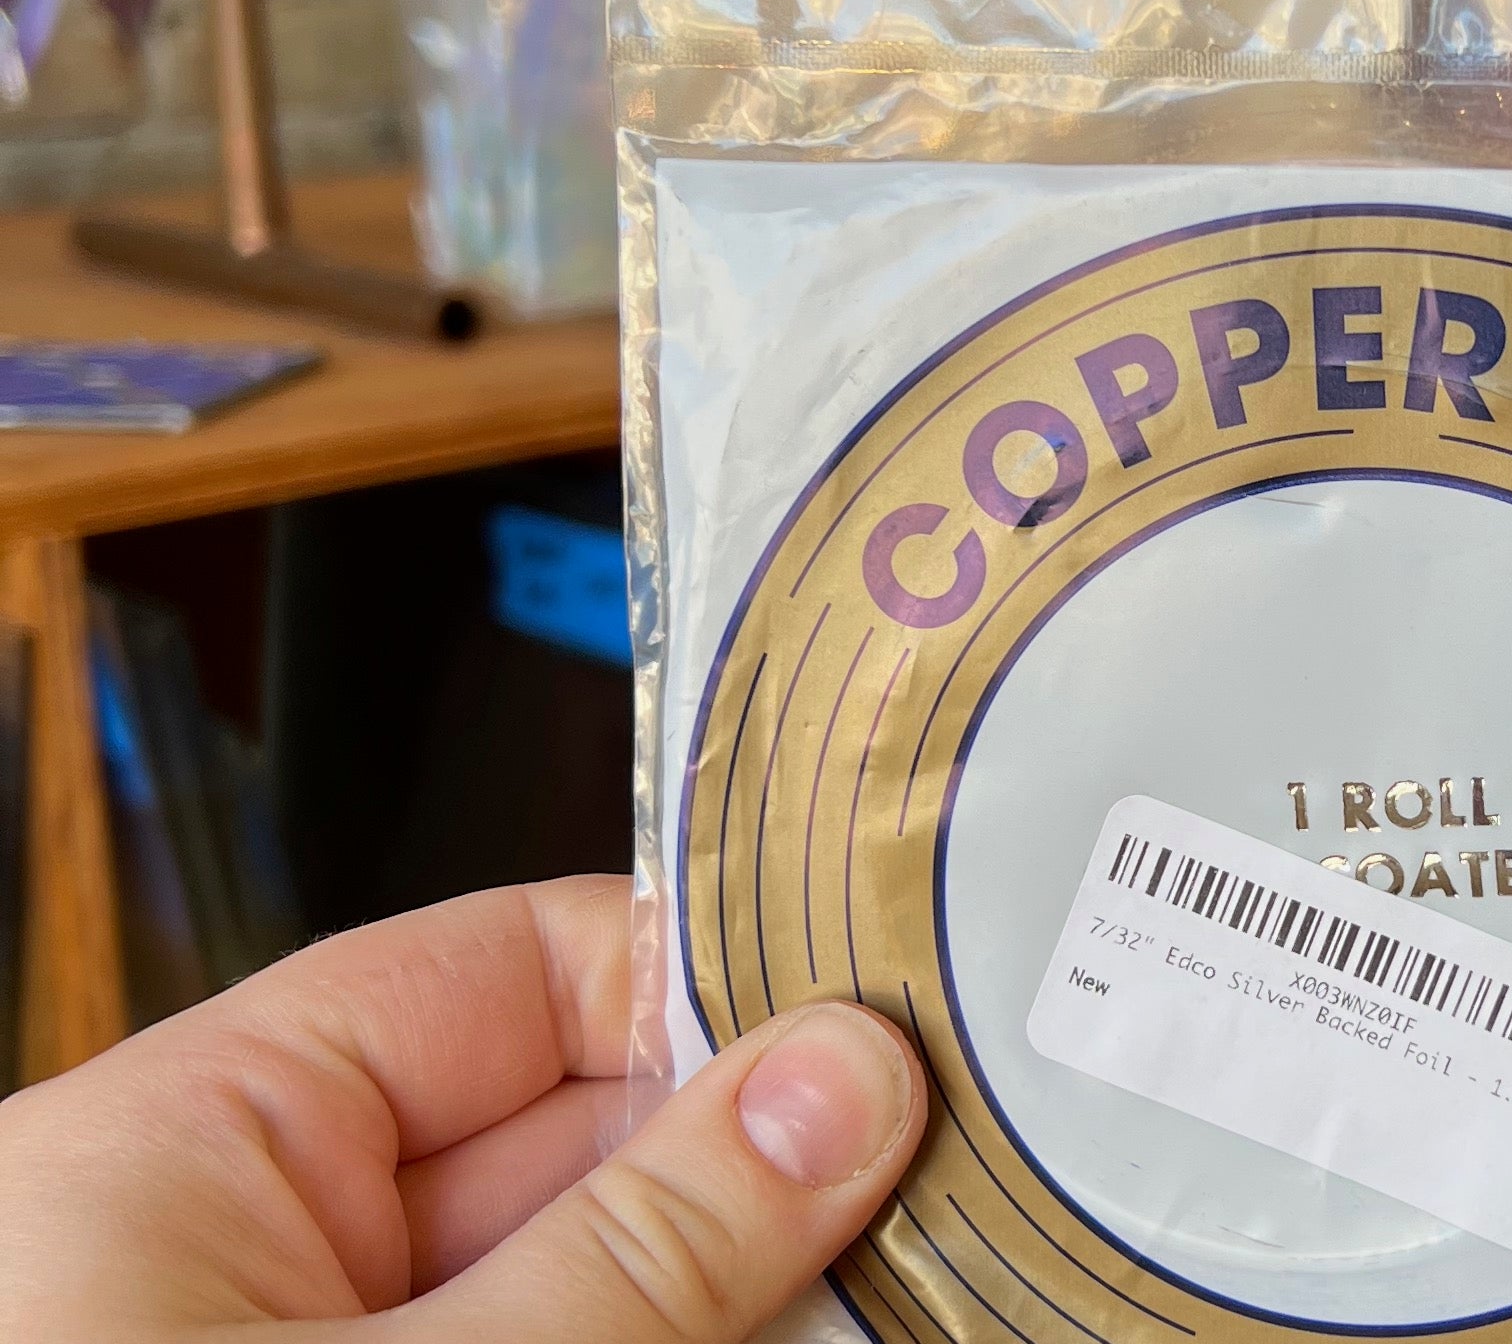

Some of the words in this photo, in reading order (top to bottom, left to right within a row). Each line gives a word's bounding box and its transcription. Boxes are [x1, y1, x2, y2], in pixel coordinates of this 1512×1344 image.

[862, 286, 1507, 629] COPPER
[1286, 781, 1310, 833] 1
[1342, 776, 1501, 833] ROLL
[1067, 965, 1111, 997] New
[1088, 916, 1155, 952] 7/32"
[1165, 944, 1217, 980] Edco
[1227, 970, 1305, 1012] Silver
[1315, 1005, 1394, 1051] Backed
[1403, 1041, 1453, 1077] Foil
[1288, 970, 1418, 1035] X003WNZ0IF
